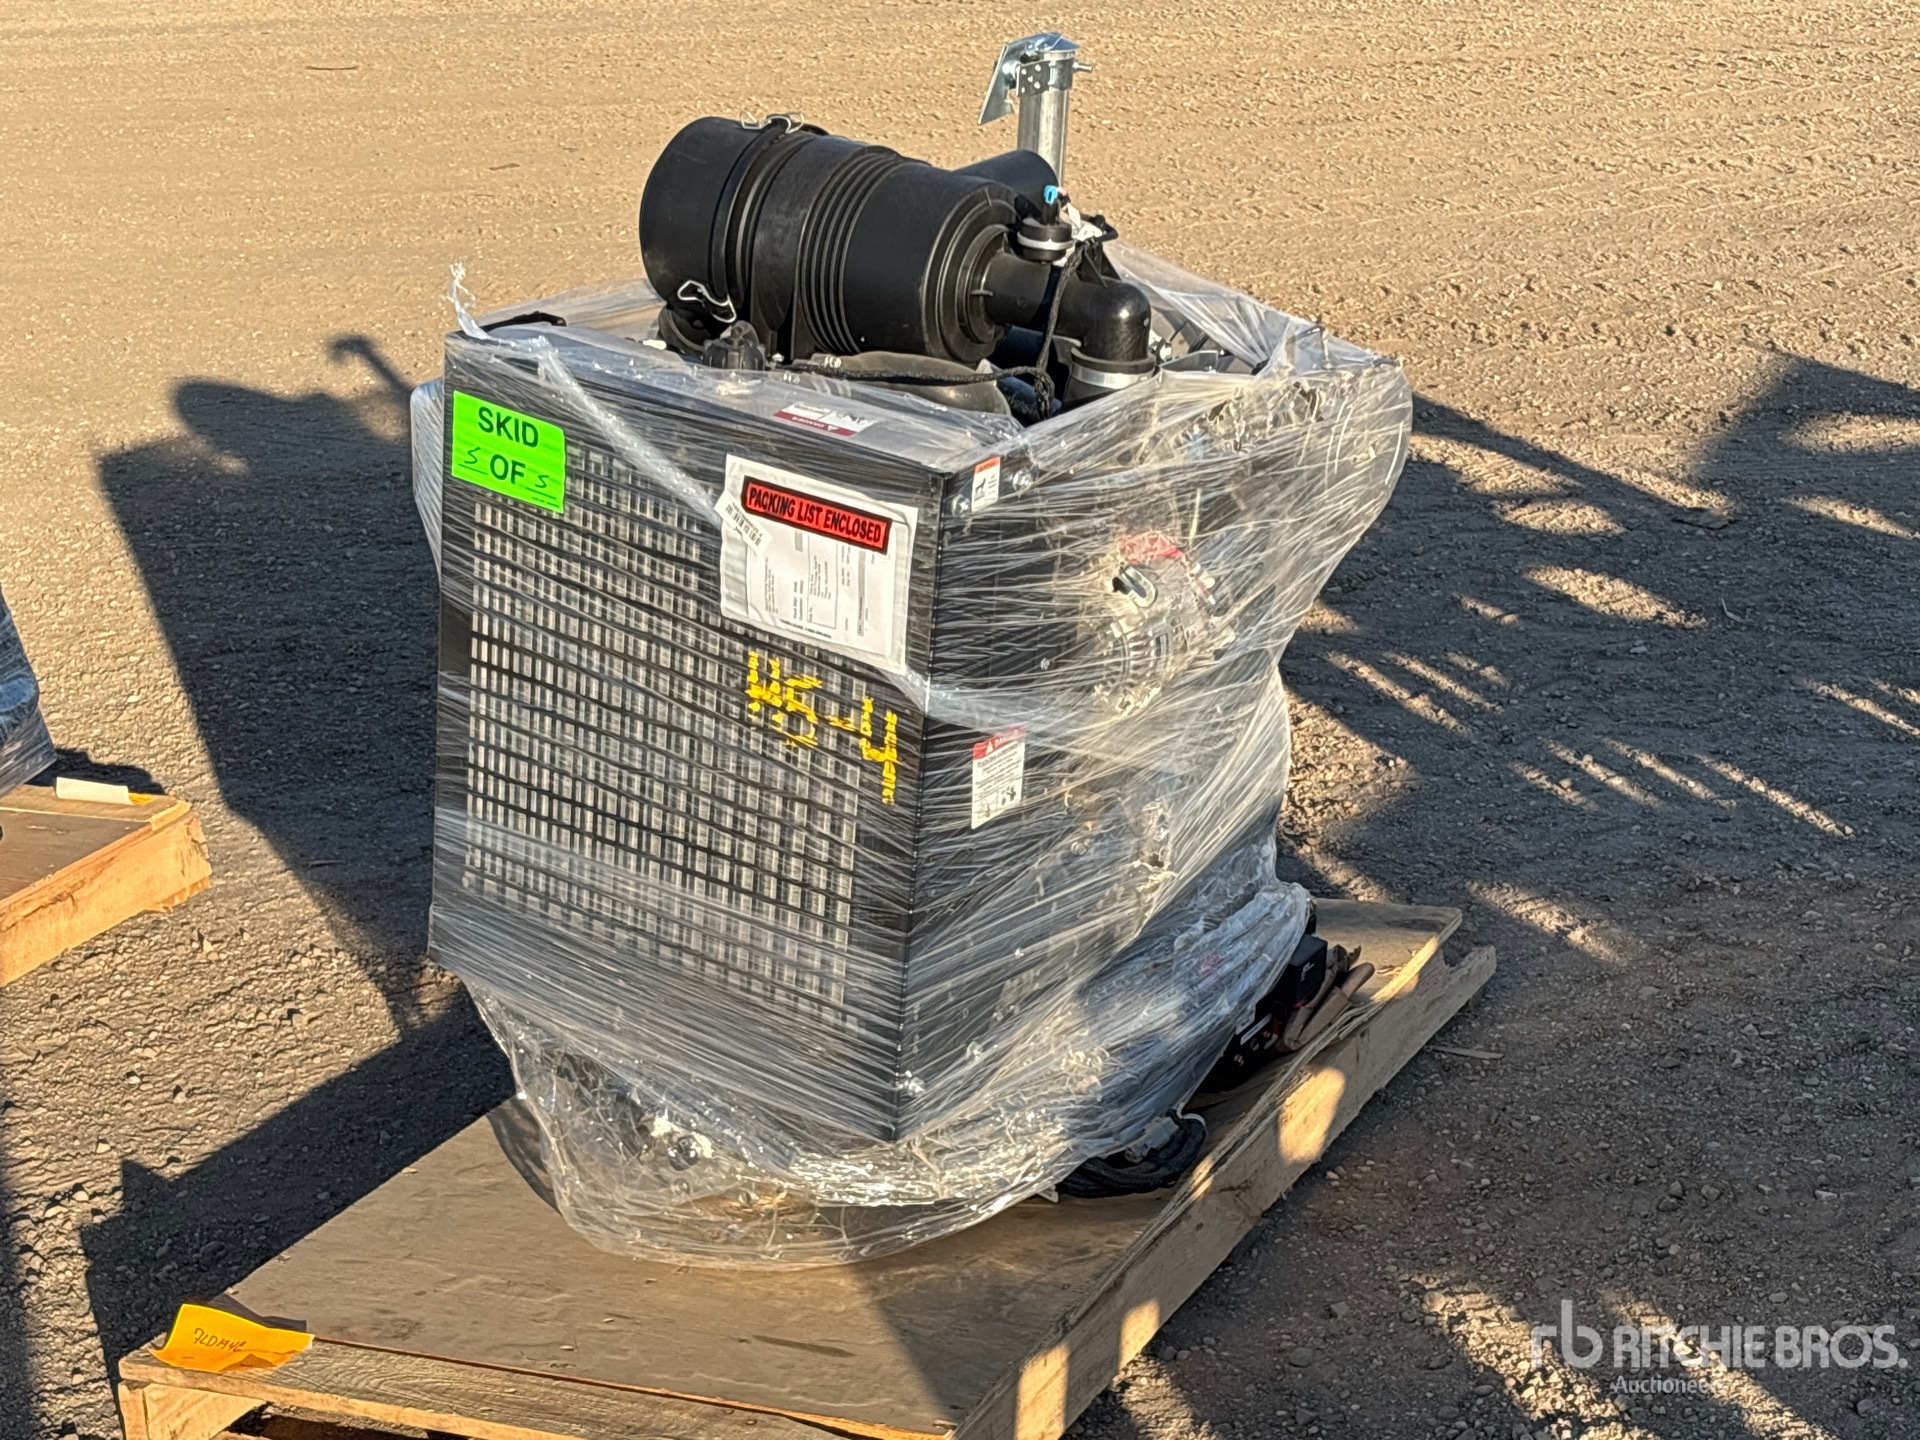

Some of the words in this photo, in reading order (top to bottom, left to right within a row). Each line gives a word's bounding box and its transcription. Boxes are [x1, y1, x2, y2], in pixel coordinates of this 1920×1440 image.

[478, 406, 539, 448] SKID
[490, 454, 526, 485] OF
[749, 487, 795, 518] PACKING
[796, 501, 824, 526] LIST
[824, 510, 881, 544] ENCLOSED
